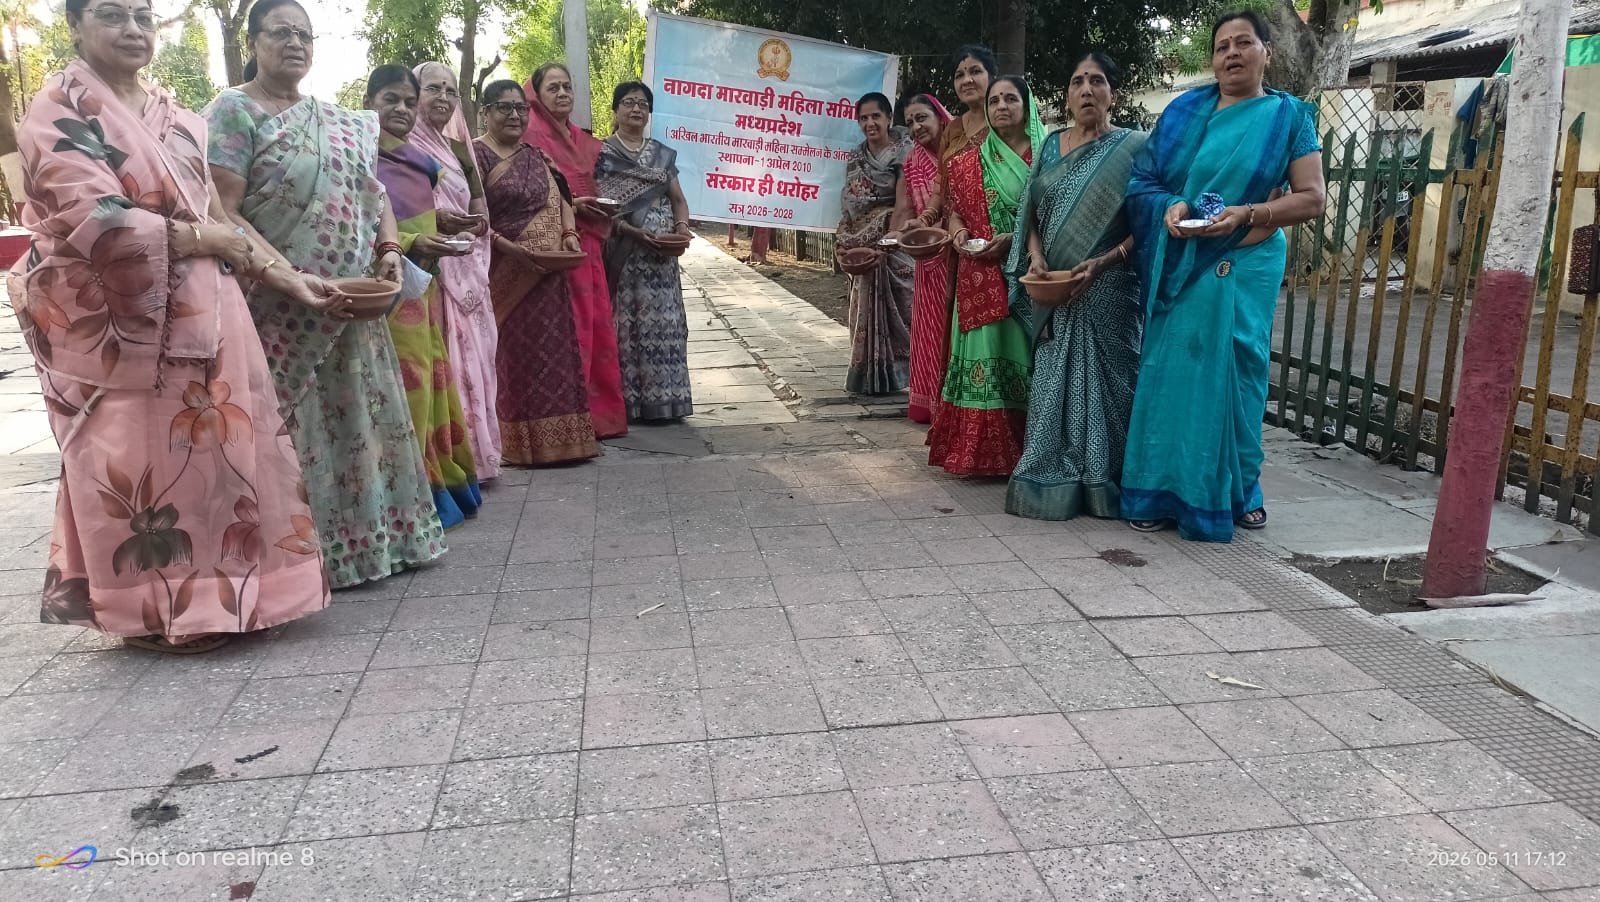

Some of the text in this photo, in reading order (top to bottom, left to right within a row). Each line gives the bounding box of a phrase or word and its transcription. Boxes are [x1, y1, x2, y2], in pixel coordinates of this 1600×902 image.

[664, 78, 860, 120] नागदा मारवाड़ी महिला समि
[735, 114, 802, 137] मध्यप्रदेश
[671, 126, 698, 142] अखिल
[700, 131, 731, 147] भारतीय
[732, 137, 763, 153] मारवाड़ी
[765, 139, 789, 154] महिला
[791, 143, 822, 158] सम्मेलन
[824, 145, 832, 159] के
[792, 160, 812, 173] 2010
[706, 166, 820, 201] संस्कार ही धरोहर
[747, 205, 794, 219] 2026-2028
